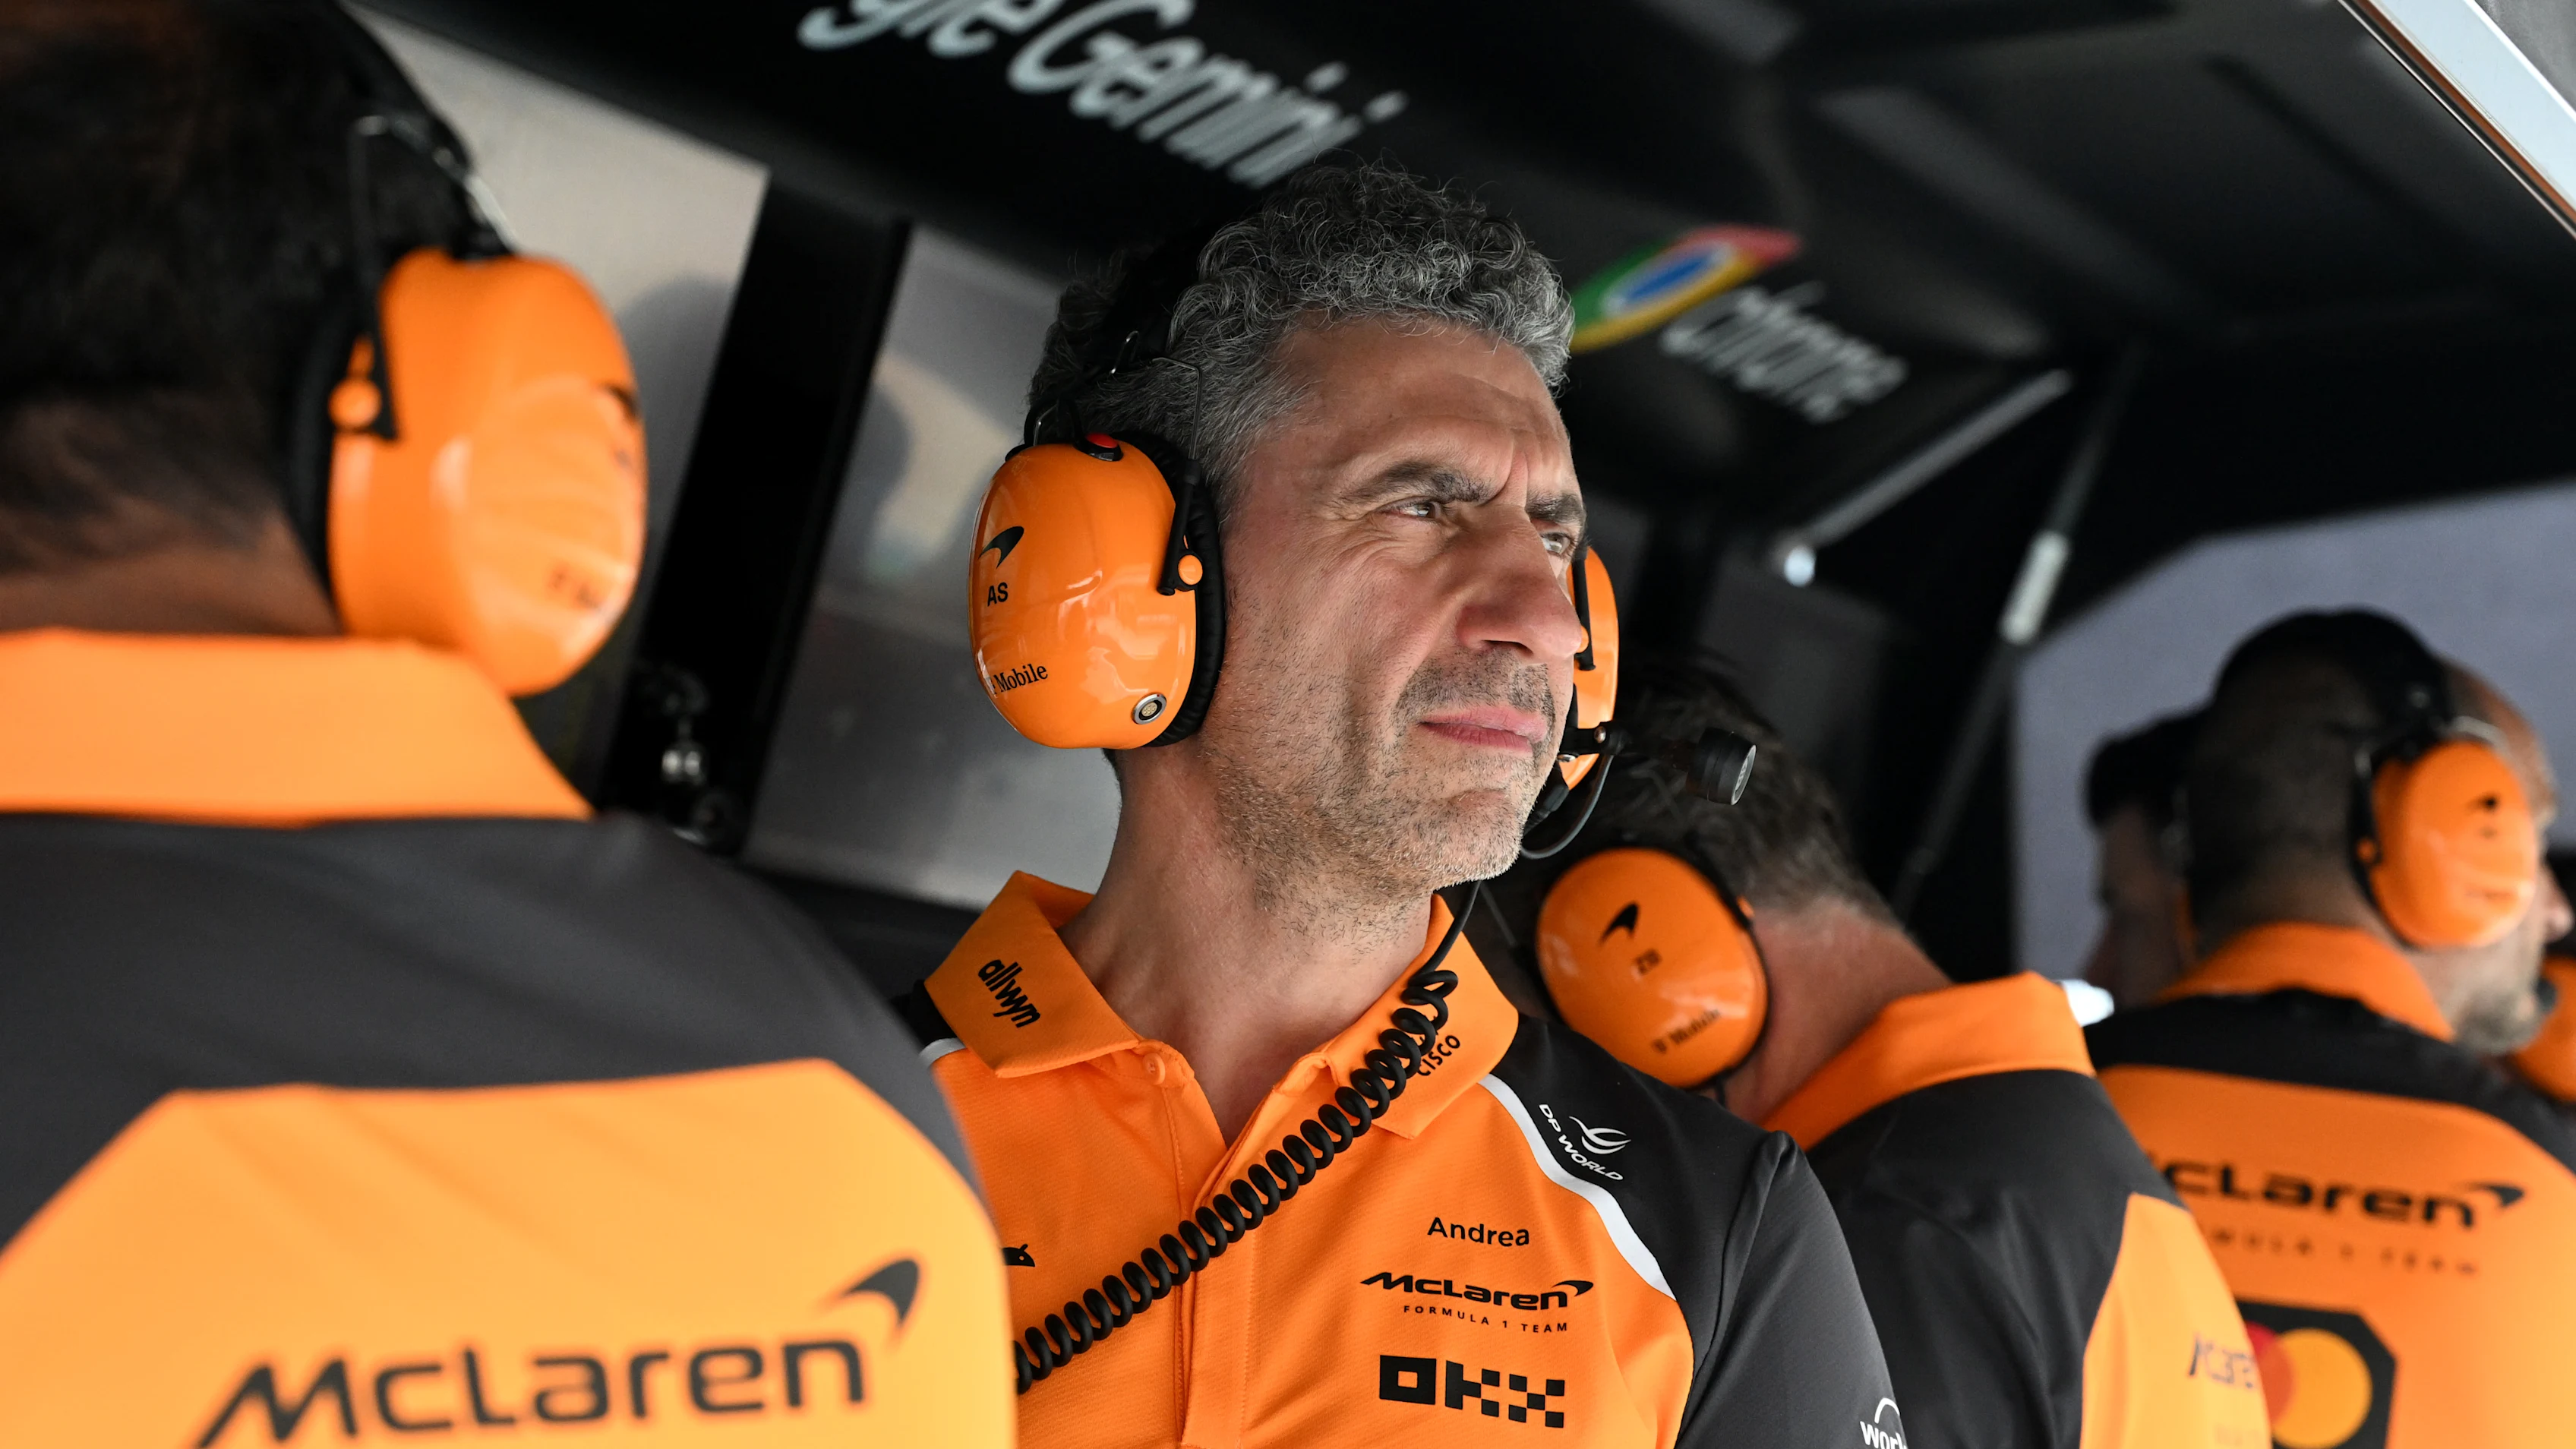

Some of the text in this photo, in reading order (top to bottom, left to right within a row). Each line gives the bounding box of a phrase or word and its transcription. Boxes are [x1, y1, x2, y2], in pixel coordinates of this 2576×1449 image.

[1009, 0, 1406, 188] Gemini
[987, 582, 1009, 607] AS
[993, 663, 1048, 693] Mobile
[978, 959, 1041, 1028] allwyn
[1539, 1104, 1624, 1180] DP WORLD
[2152, 1158, 2474, 1230] cLaren
[1427, 1217, 1530, 1247] Andrea
[1359, 1271, 1568, 1311] McLaren
[1403, 1305, 1489, 1325] FORMULA
[1520, 1322, 1567, 1333] TEAM
[190, 1340, 864, 1448] McLaren
[1379, 1354, 1565, 1428] OKX
